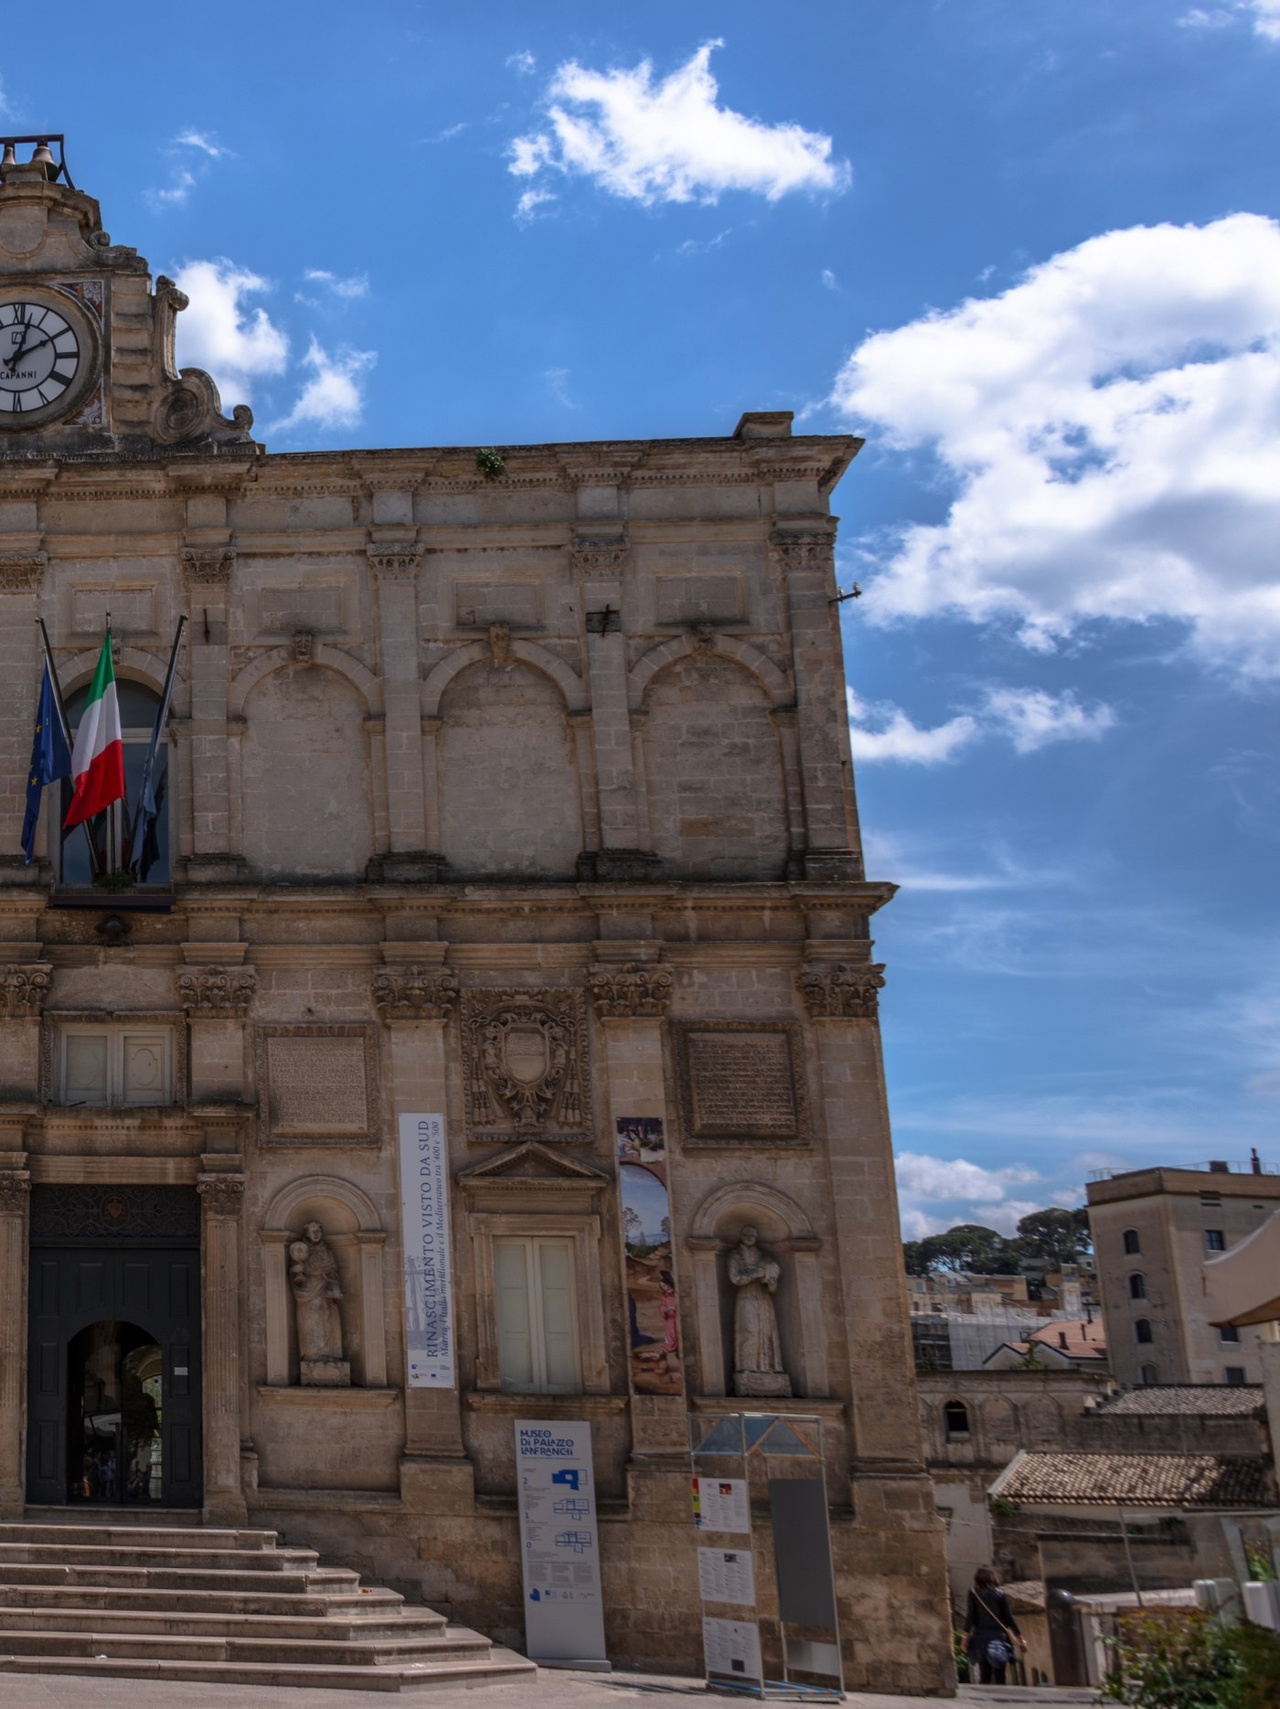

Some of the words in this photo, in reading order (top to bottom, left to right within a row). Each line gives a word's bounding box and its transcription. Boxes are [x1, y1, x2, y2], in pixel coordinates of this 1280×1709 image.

[0, 370, 37, 380] CAPANNI
[418, 1120, 430, 1151] SUD
[419, 1156, 431, 1176] DA
[434, 1165, 442, 1177] tra
[420, 1182, 433, 1228] VISTO
[434, 1178, 444, 1231] Mediterraneo
[437, 1247, 446, 1294] meridionale
[422, 1233, 438, 1358] RINASCIMENTO
[520, 1429, 552, 1438] MUSEO
[533, 1438, 574, 1447] PALAZZO
[522, 1477, 528, 1485] 2
